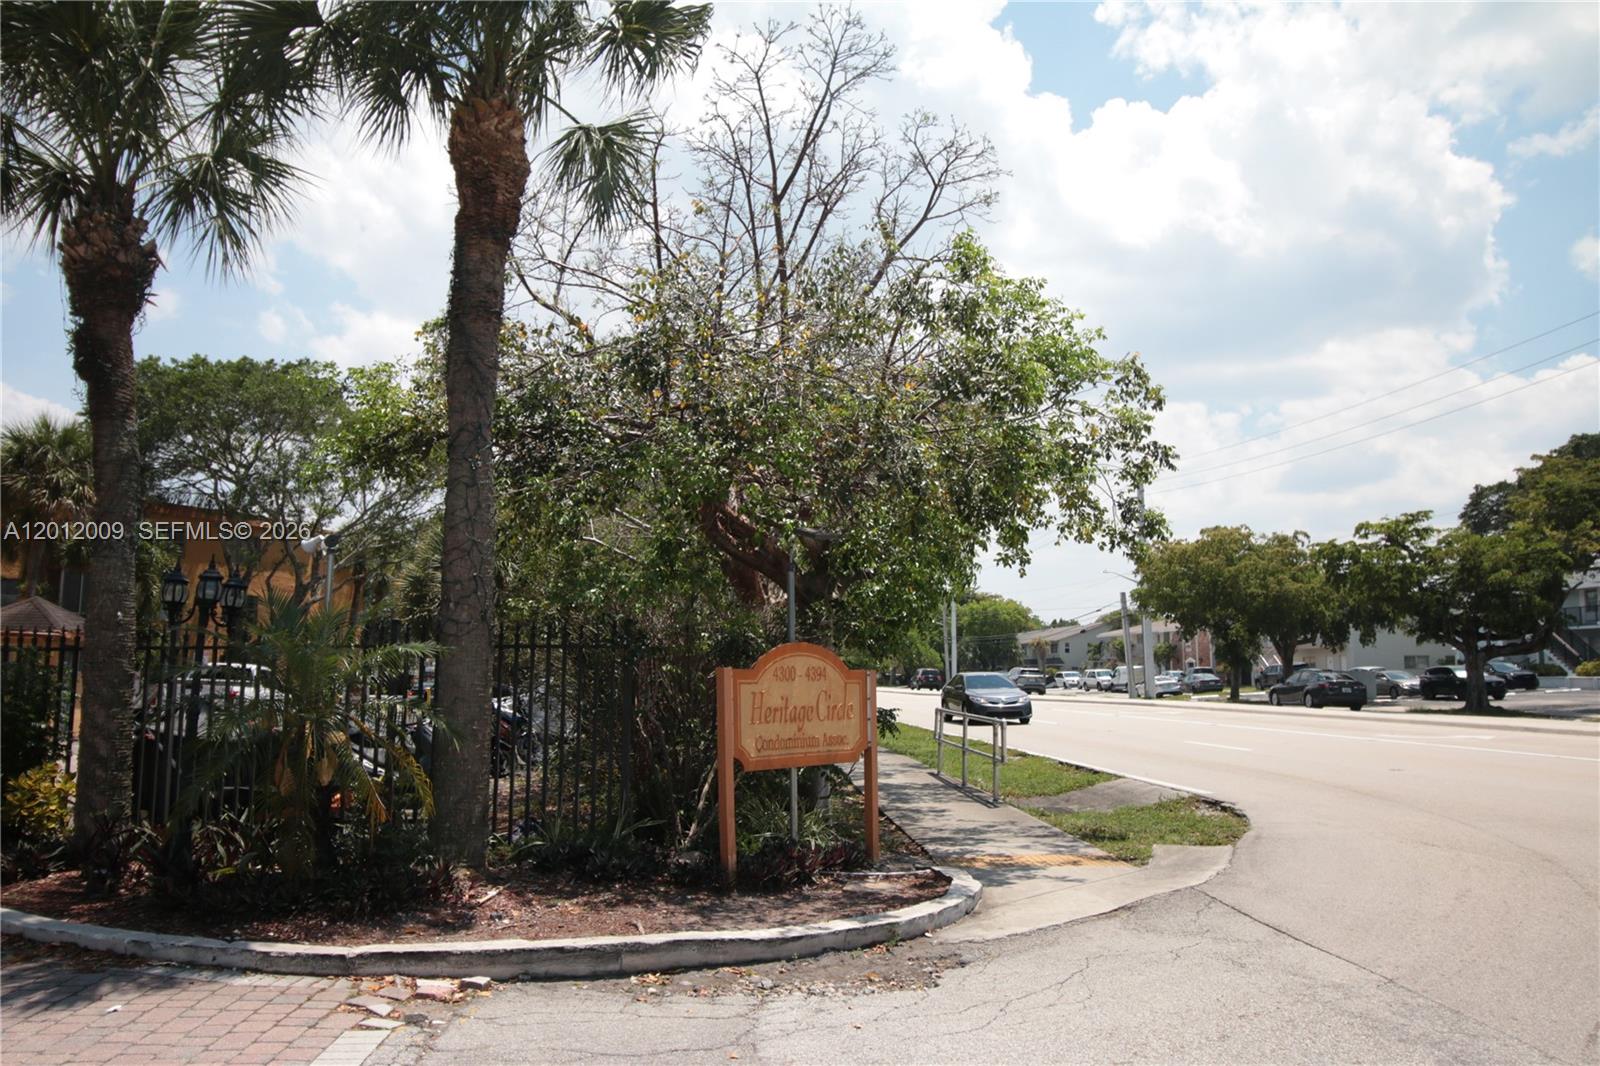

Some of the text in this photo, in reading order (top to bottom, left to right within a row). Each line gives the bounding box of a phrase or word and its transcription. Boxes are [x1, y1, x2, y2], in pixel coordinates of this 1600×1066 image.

[773, 666, 796, 682] 4300
[805, 665, 827, 682] 4394
[750, 689, 855, 732] Heritage Circle
[755, 733, 820, 753] Condominium
